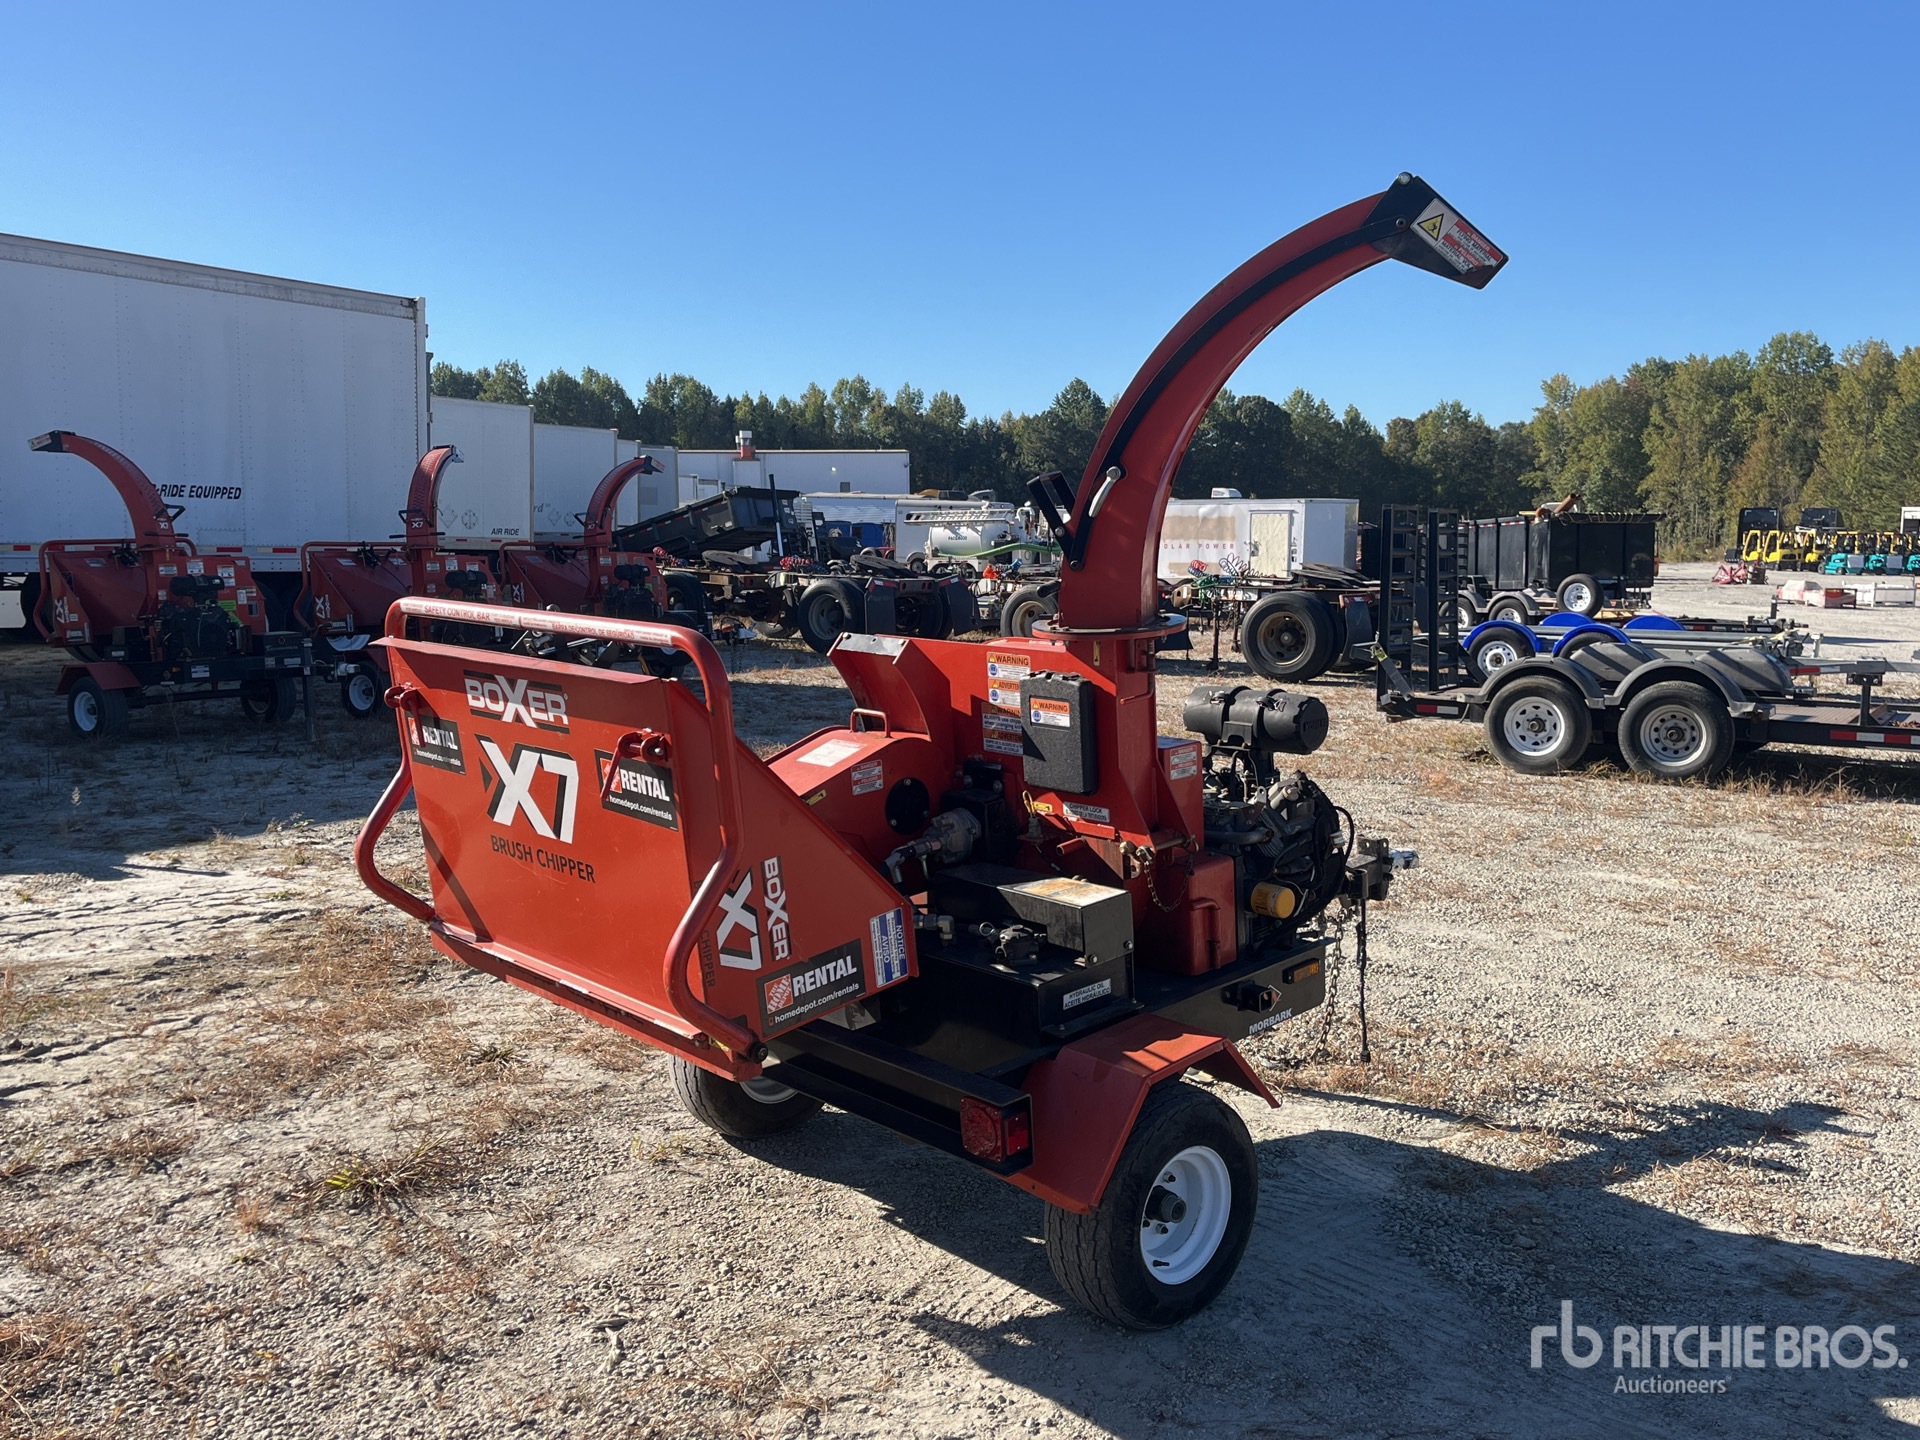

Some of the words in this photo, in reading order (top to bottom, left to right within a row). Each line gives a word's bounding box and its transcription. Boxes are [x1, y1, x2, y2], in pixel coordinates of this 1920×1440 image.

[1471, 233, 1491, 251] DANGER
[1458, 246, 1479, 266] PELIGRO
[188, 485, 242, 500] EQUIPPED
[491, 527, 504, 536] AIR
[504, 528, 520, 536] RIDE
[54, 599, 65, 624] X7
[314, 596, 325, 619] X7
[424, 604, 446, 616] SAFETY
[447, 607, 476, 619] CONTROL
[476, 611, 490, 620] BAR
[996, 654, 1029, 666] WARNING
[464, 675, 568, 728] BOXER
[1039, 702, 1068, 713] WARNING
[422, 725, 459, 750] RENTAL
[480, 740, 579, 844] X7
[620, 769, 670, 801] RENTAL
[609, 794, 673, 821] homedepot.com/rentals
[1069, 803, 1089, 812] CHIPPER
[1089, 806, 1103, 814] LOCK
[490, 834, 534, 863] BRUSH
[536, 848, 596, 883] CHIPPER
[716, 871, 762, 970] X7
[764, 856, 789, 960] BOXER
[881, 935, 891, 963] AVISO
[896, 924, 906, 960] NOTICE
[699, 929, 716, 988] CHIPPER
[792, 955, 857, 997] RENTAL
[768, 976, 790, 1012] HOME
[769, 982, 779, 997] THE
[1069, 984, 1096, 999] HYDRAULIC
[1097, 982, 1105, 990] OIL
[775, 982, 859, 1023] homedepot.com/rentals
[1064, 998, 1081, 1008] ACEITE
[1249, 1008, 1293, 1034] MORBARK
